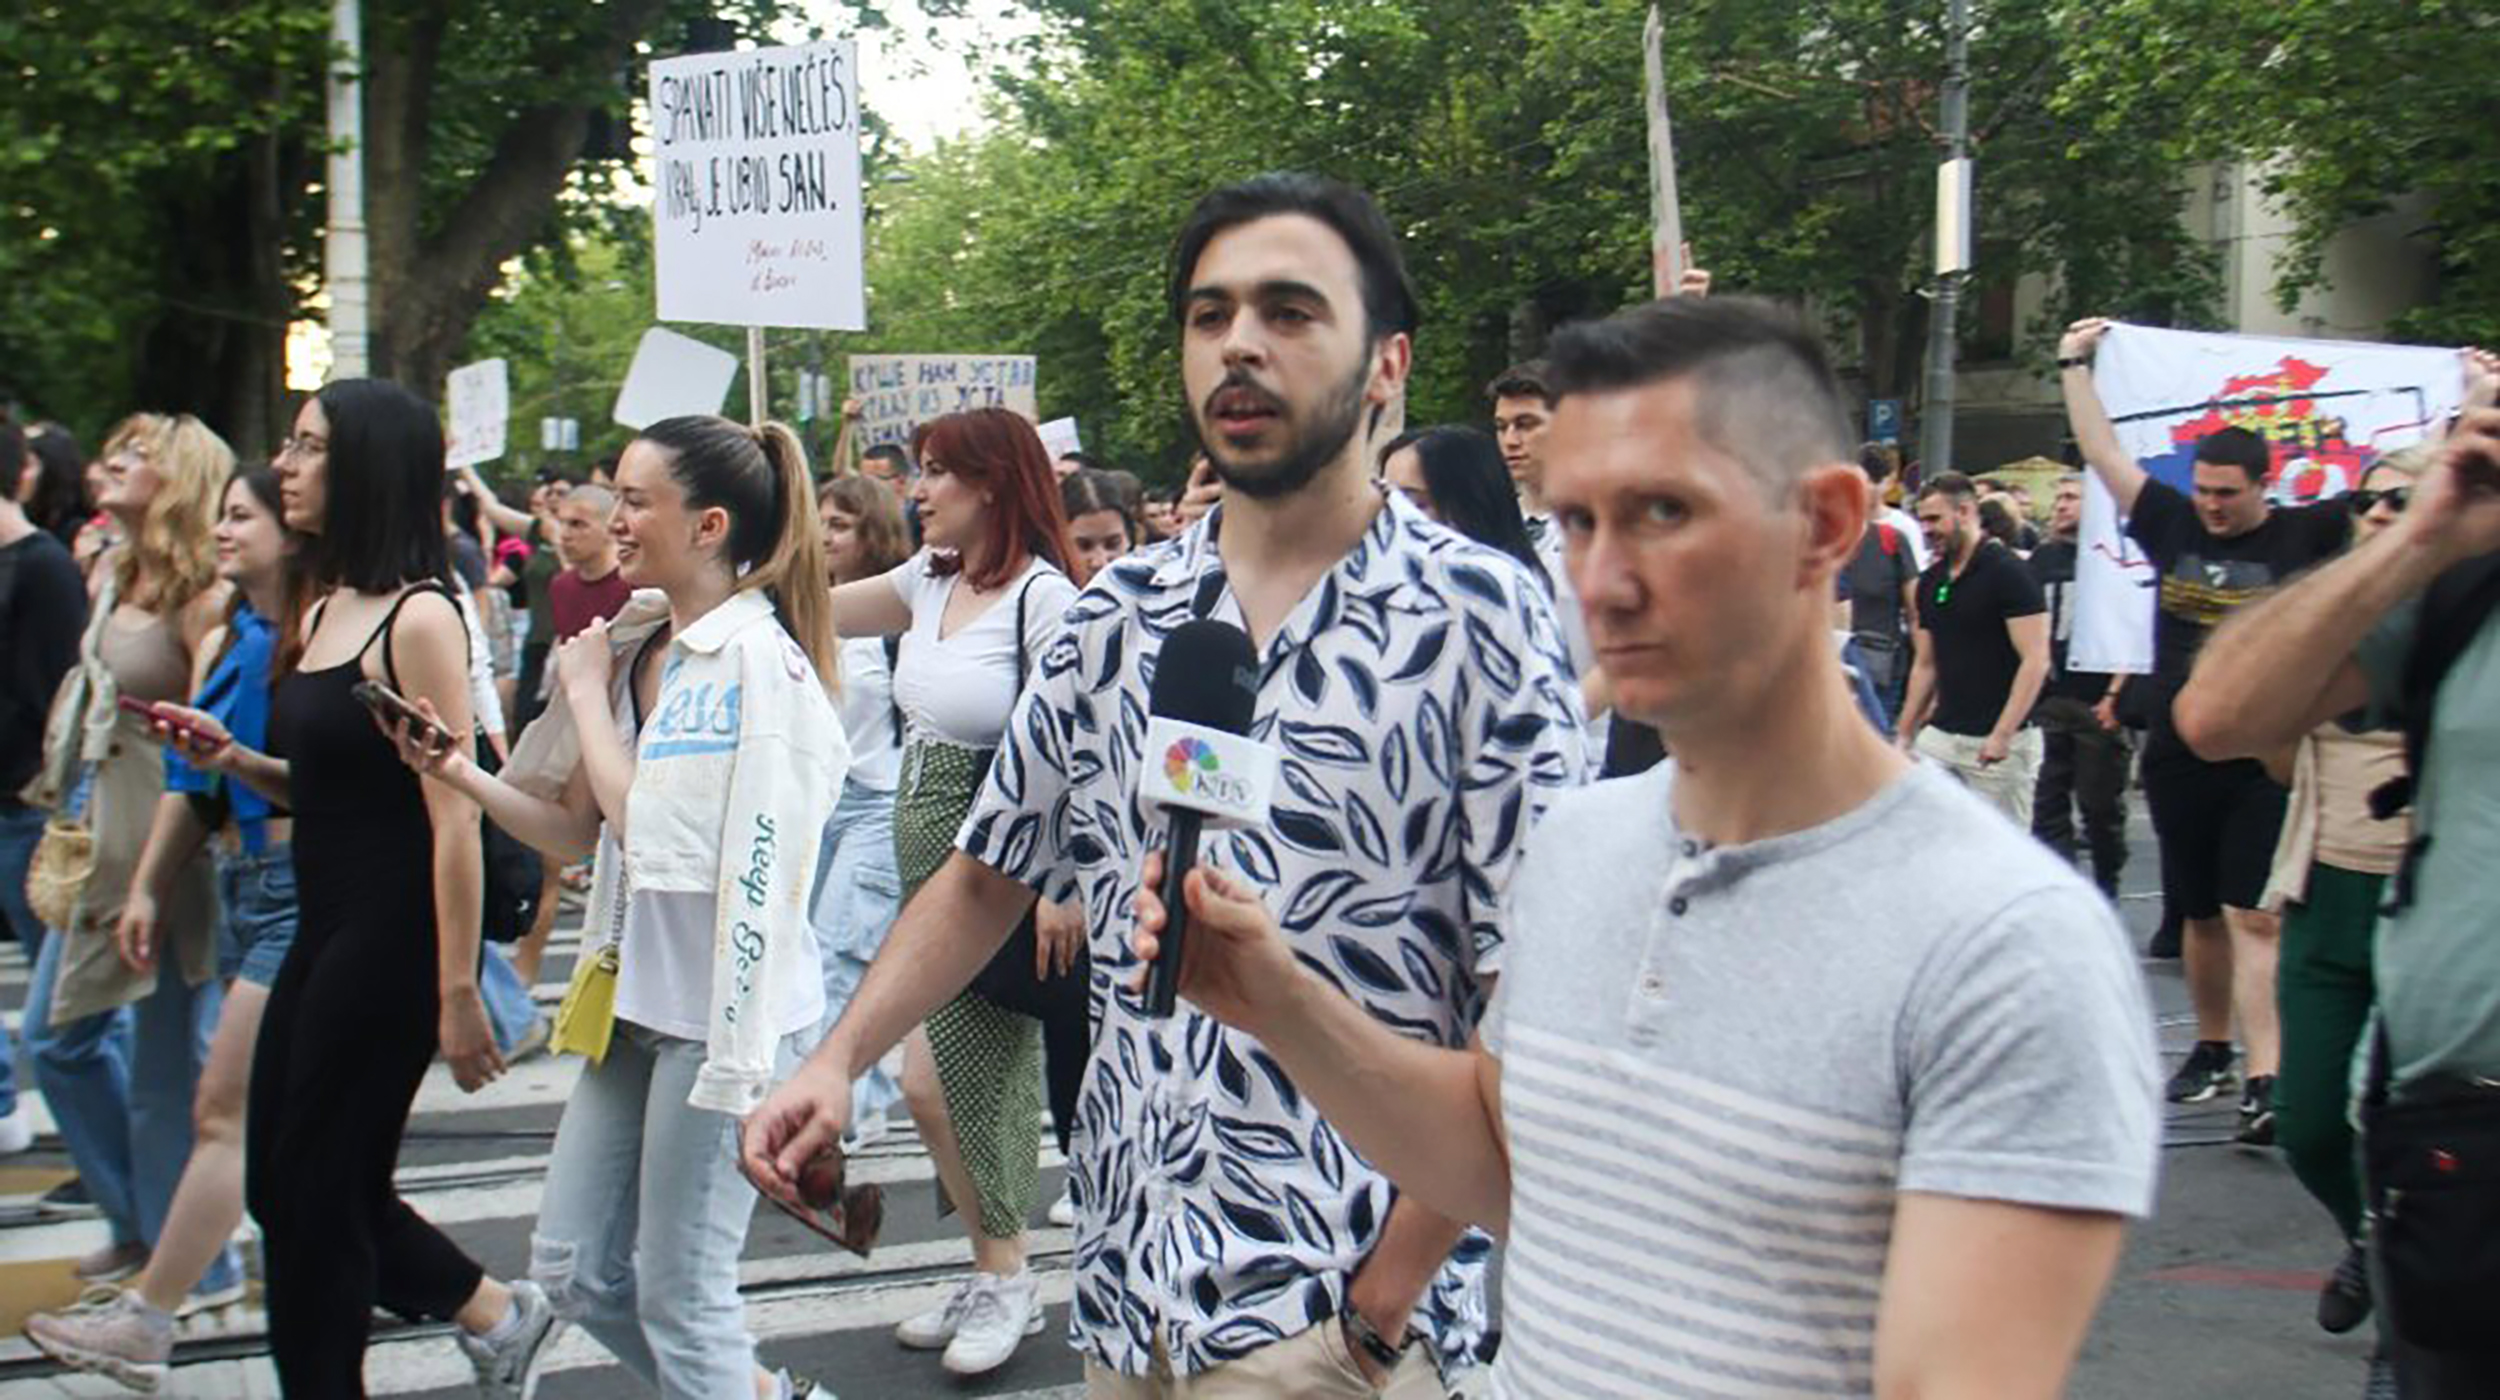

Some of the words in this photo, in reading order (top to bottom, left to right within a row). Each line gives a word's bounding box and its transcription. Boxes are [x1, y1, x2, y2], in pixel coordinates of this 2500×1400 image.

[660, 69, 731, 145] SPAVATI
[778, 150, 837, 213] SAN.
[1875, 404, 1892, 426] P
[739, 814, 776, 907] Keep
